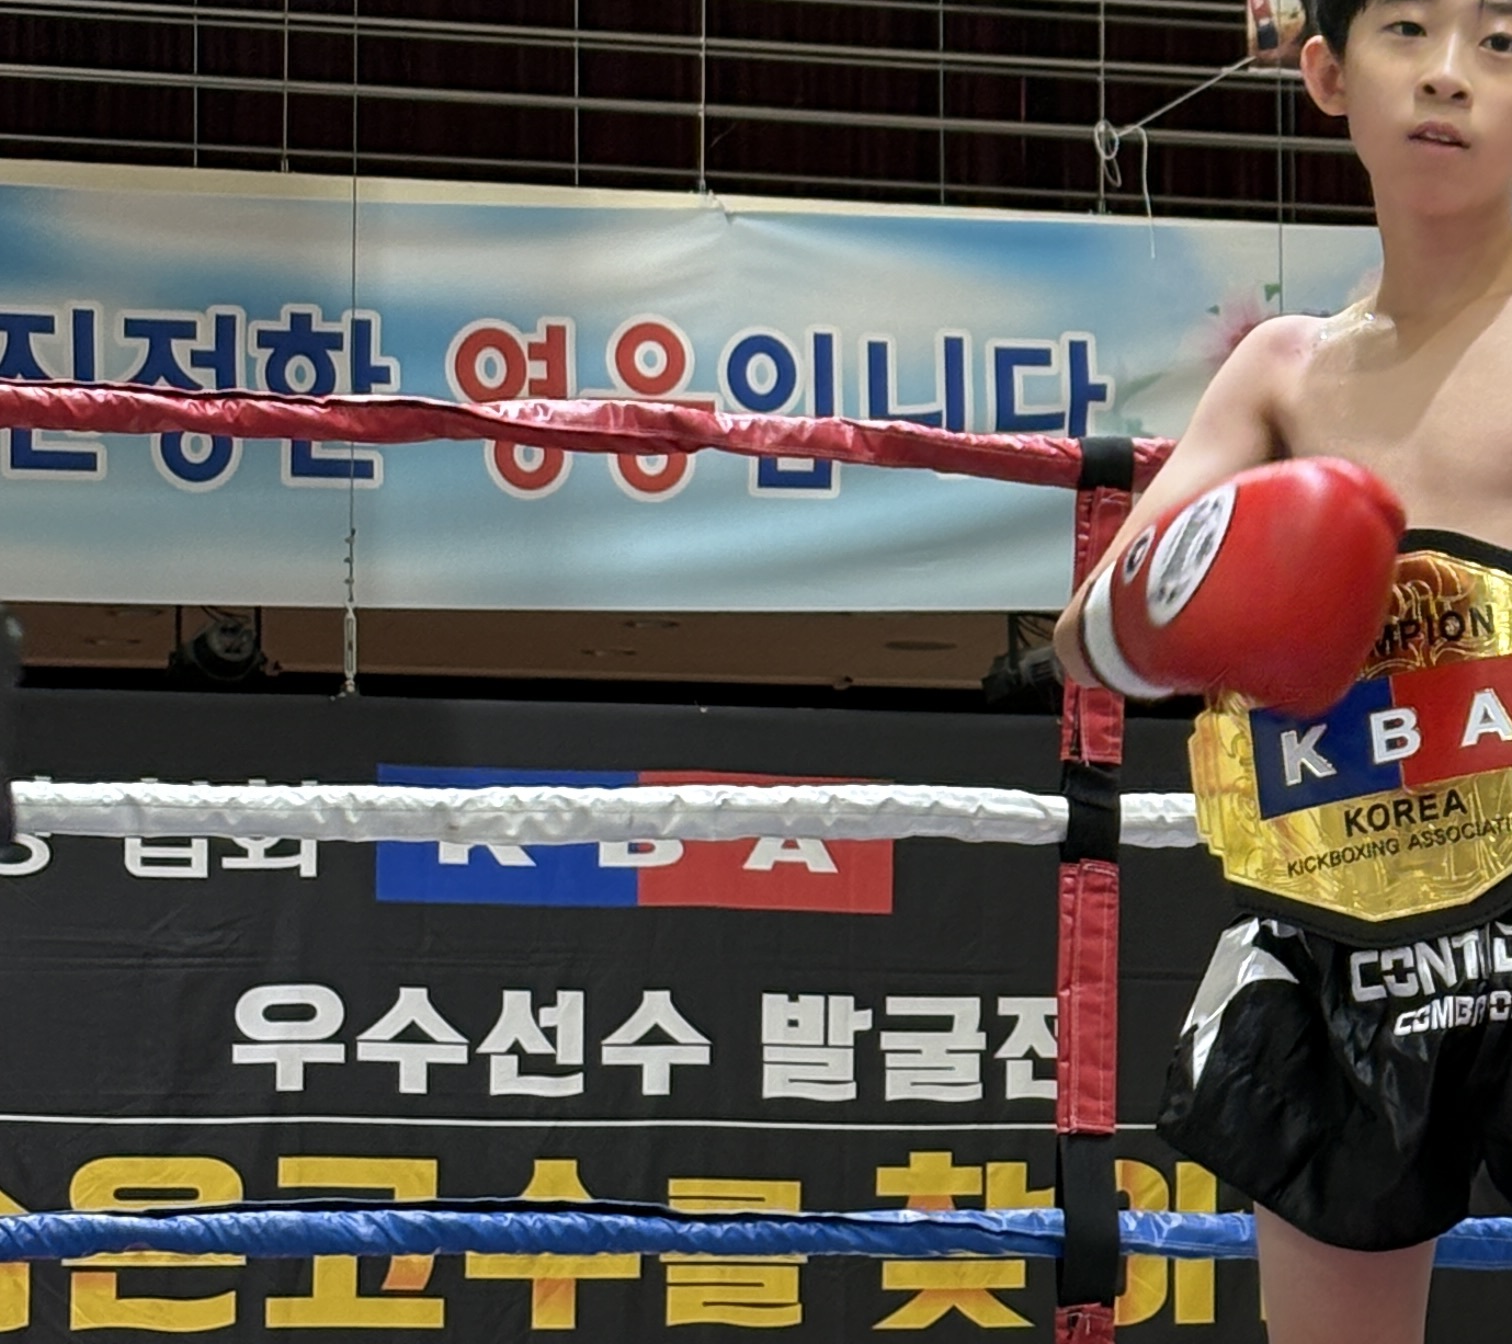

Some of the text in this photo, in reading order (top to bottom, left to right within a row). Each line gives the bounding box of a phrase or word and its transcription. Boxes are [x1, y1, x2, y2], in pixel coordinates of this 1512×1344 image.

[0, 304, 1112, 496] 진정한 영웅입니다
[1343, 787, 1468, 838] KOREA
[1286, 836, 1400, 880] KICKBOXING
[233, 983, 712, 1097] 우수선수
